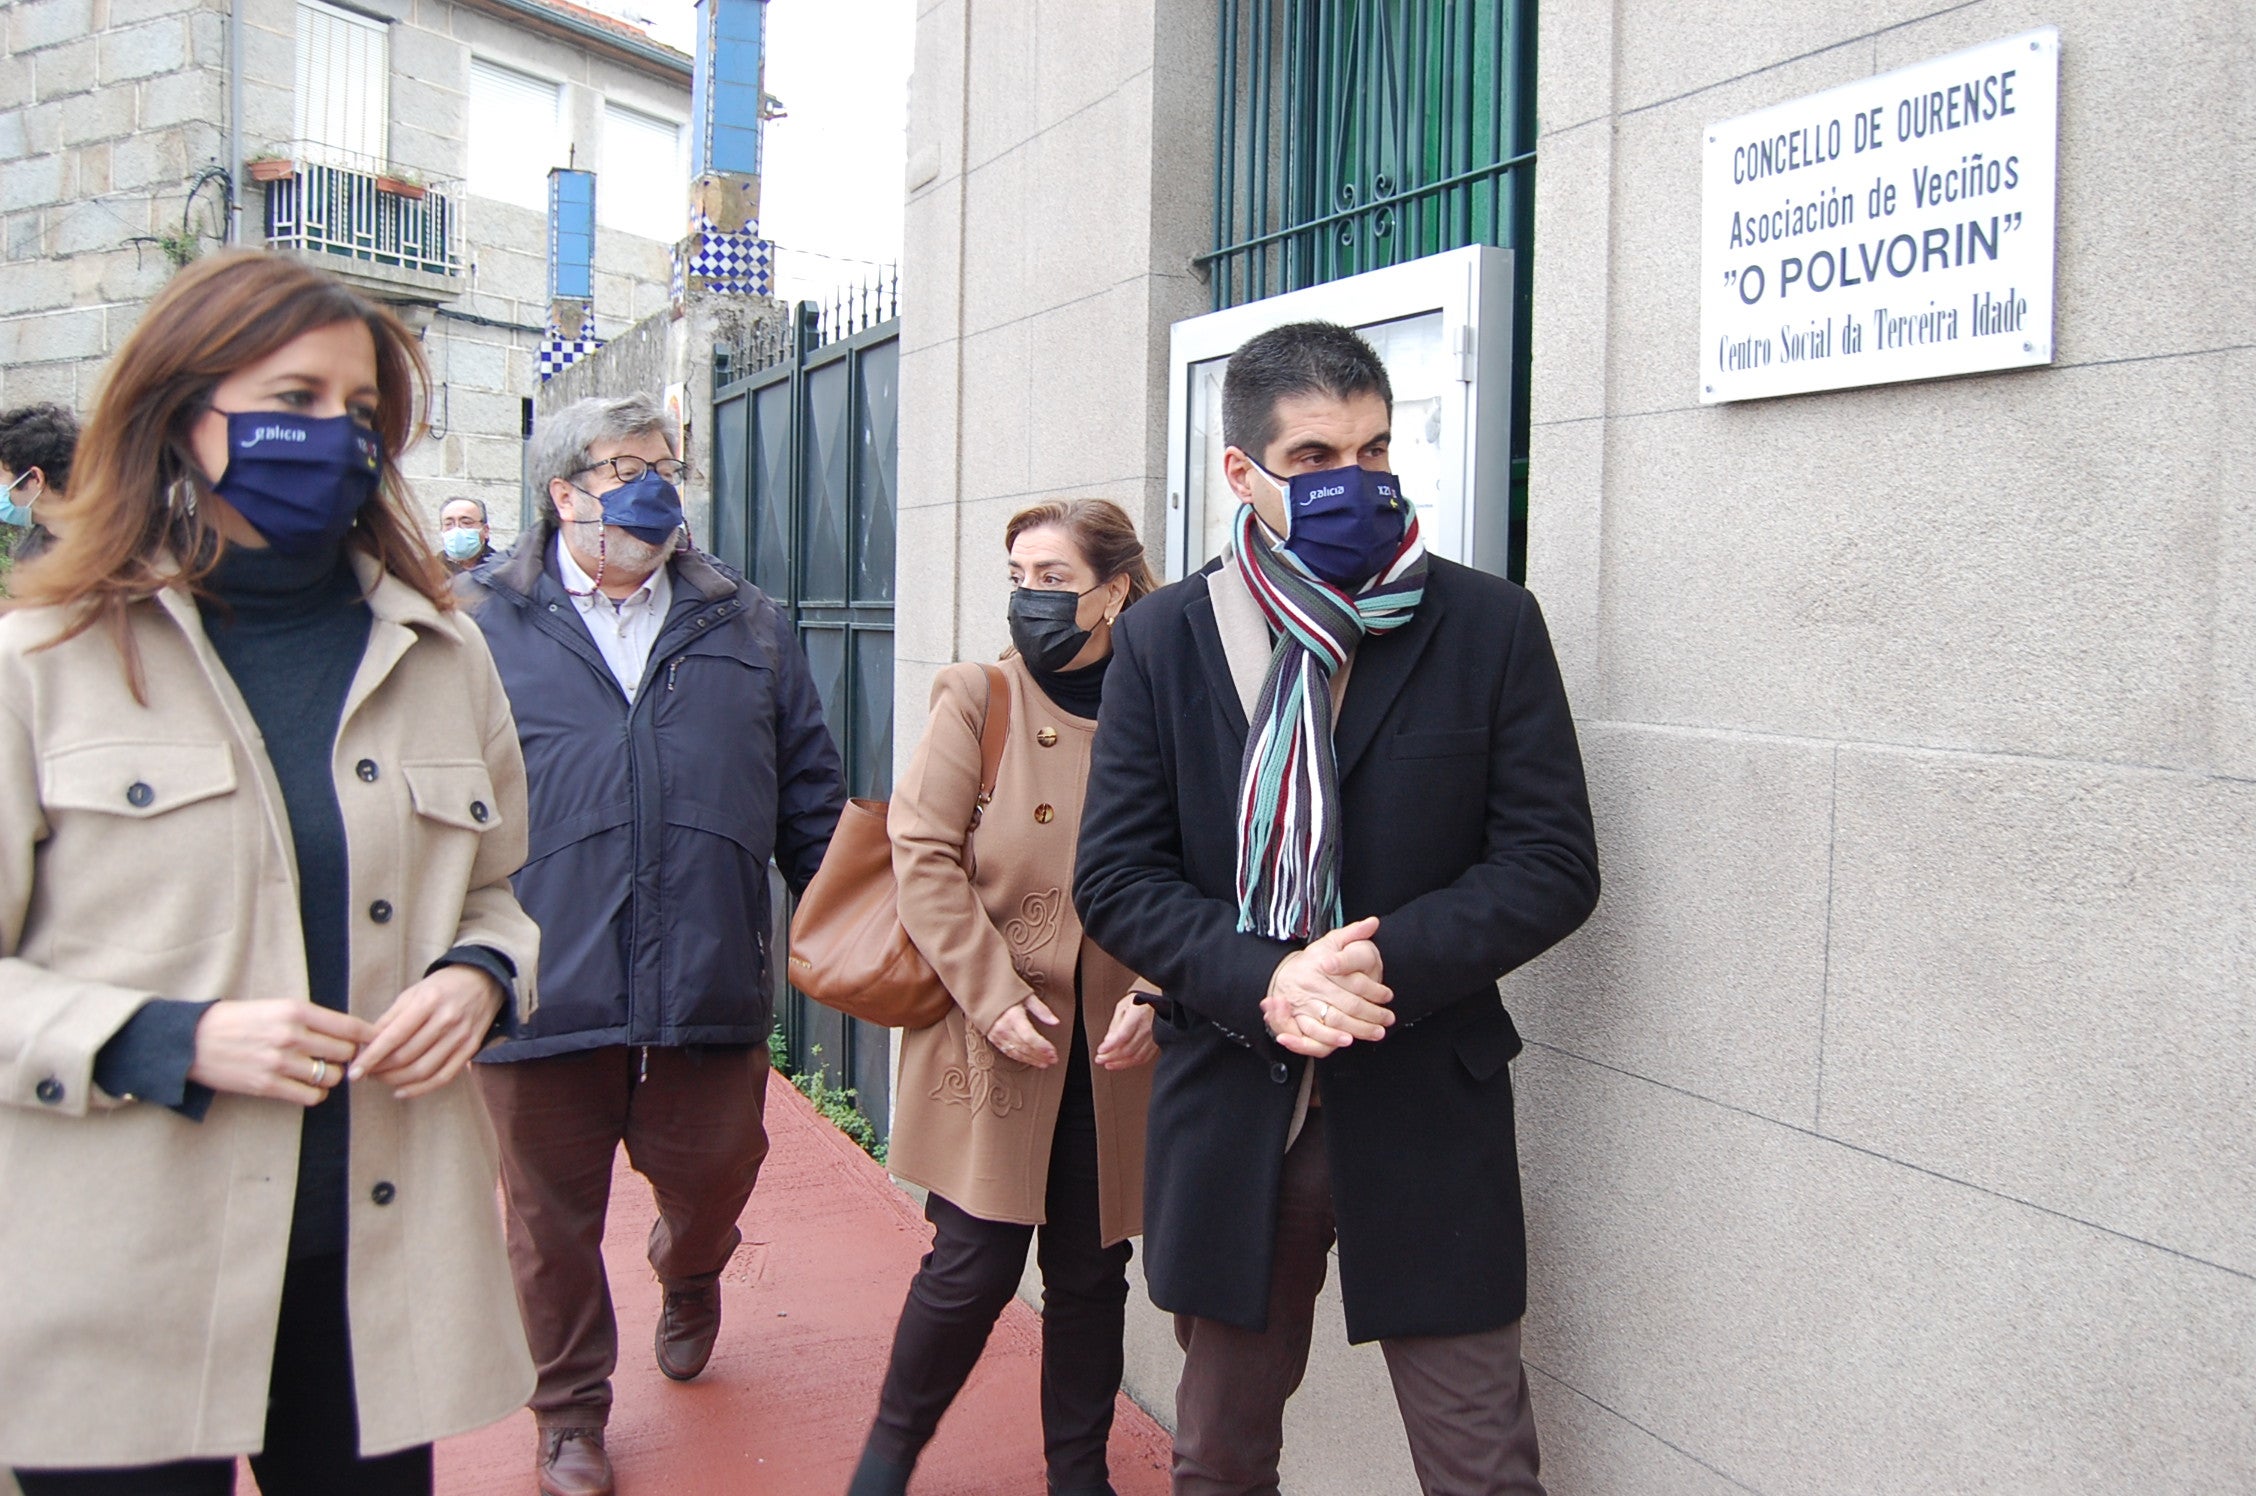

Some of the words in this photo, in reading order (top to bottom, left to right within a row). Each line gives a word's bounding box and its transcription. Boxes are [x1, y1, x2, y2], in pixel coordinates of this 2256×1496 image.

[1734, 119, 1840, 185] CONCELLO
[1854, 106, 1883, 154] DE
[1898, 69, 2016, 143] OURENSE
[1730, 186, 1853, 250] Asociación
[1868, 176, 1896, 219] de
[1912, 152, 2019, 209] Veciños
[1719, 333, 1771, 373] Centro
[1780, 316, 1831, 364] Social
[1842, 313, 1862, 355] da
[1874, 300, 1958, 351] Terceira
[1972, 287, 2027, 337] Idade
[1300, 485, 1345, 506] galicia
